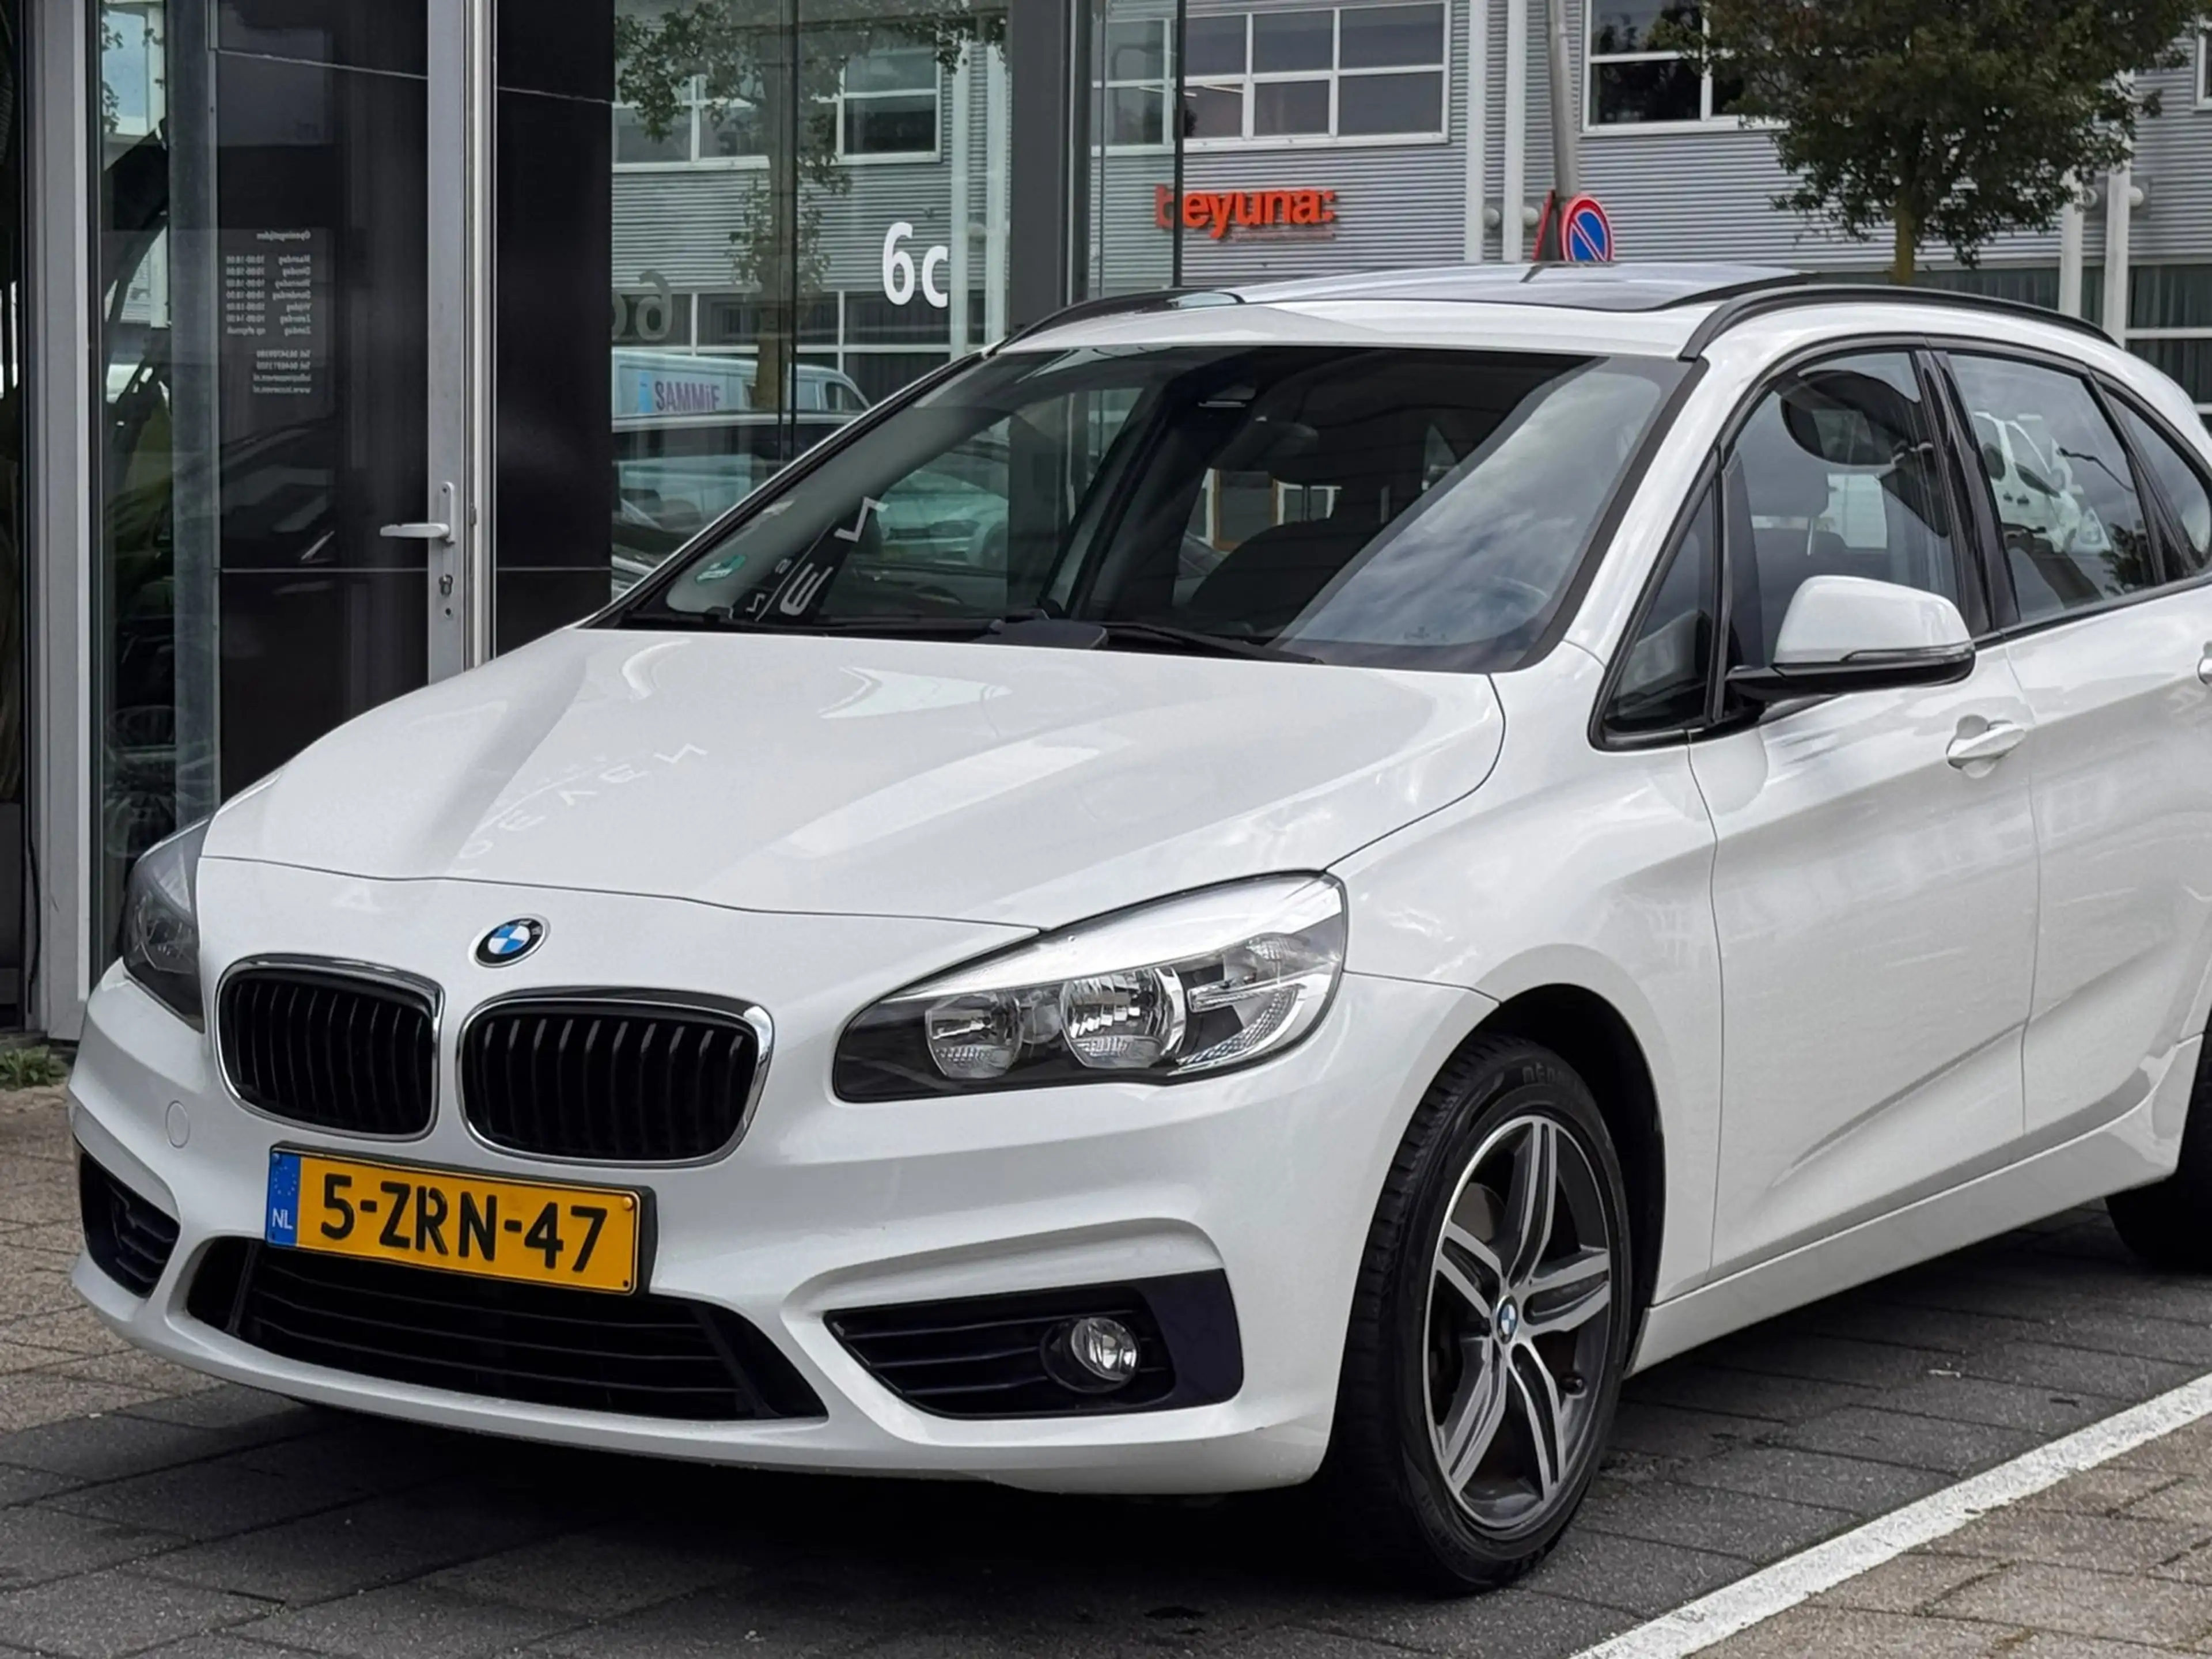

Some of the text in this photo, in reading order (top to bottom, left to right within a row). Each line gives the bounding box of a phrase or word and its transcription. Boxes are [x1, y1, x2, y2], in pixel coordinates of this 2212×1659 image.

[882, 221, 949, 308] 6c
[271, 1207, 294, 1230] NL
[320, 1172, 608, 1272] 5-ZRN-47
